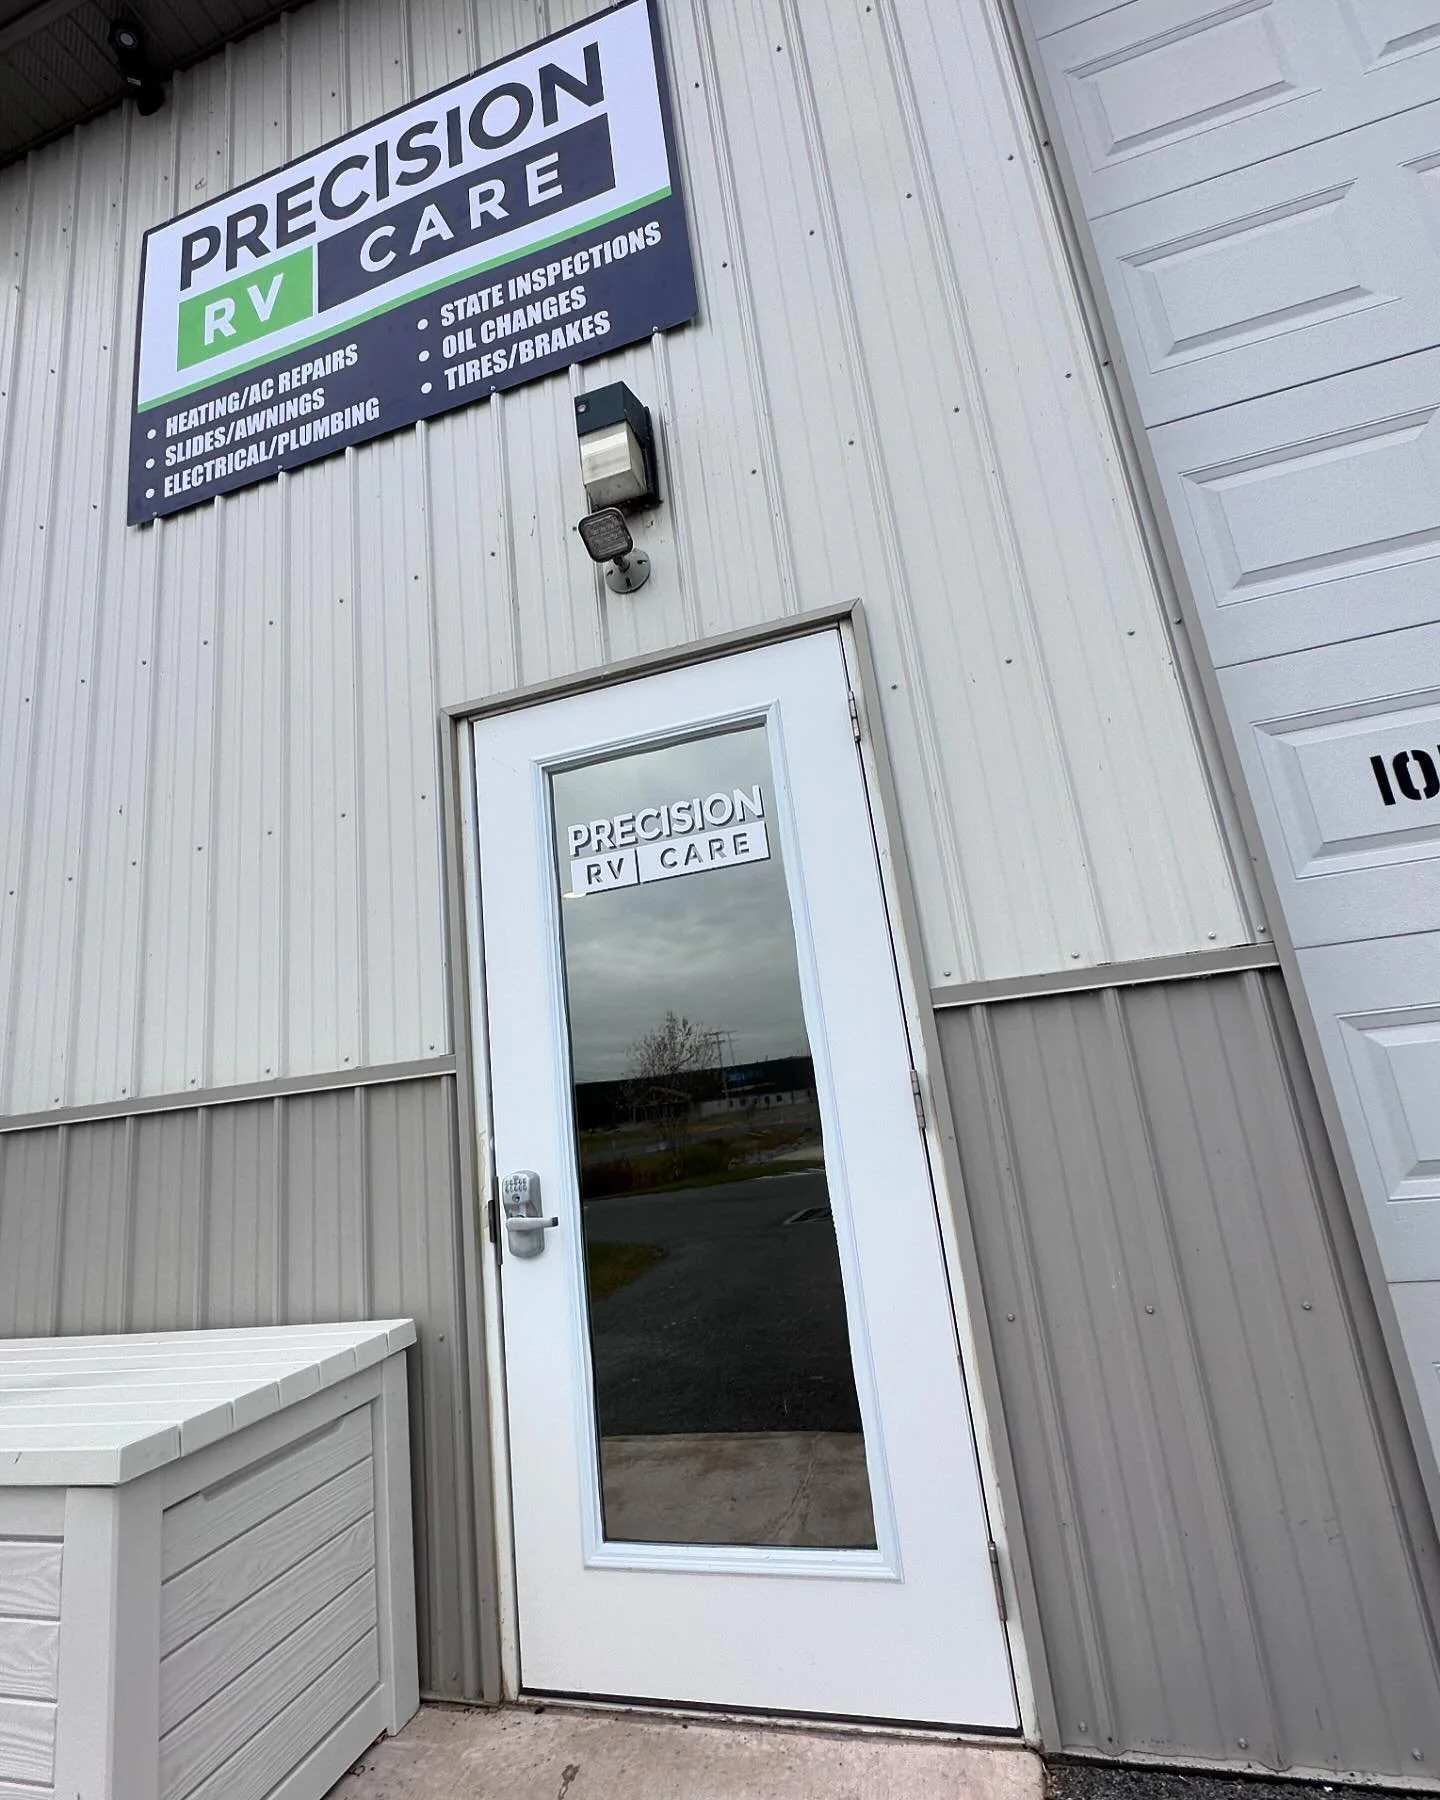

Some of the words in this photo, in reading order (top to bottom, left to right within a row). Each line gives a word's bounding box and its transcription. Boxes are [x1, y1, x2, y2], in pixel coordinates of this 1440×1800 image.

[180, 42, 604, 291] PRECISION
[203, 273, 283, 345] RV
[359, 152, 564, 273] CARE
[440, 284, 504, 327] STATE
[508, 221, 662, 301] INSPECTIONS
[442, 331, 475, 359] OIL
[480, 285, 586, 343] CHANGES
[444, 310, 611, 391] TIRES/BRAKES
[164, 387, 325, 467] SLIDES/AWNINGS
[165, 377, 274, 438] HEATING/AC
[278, 343, 359, 393] REPAIRS
[163, 397, 380, 498] ELECTRICAL/PLUMBING
[1370, 744, 1440, 806] 10
[568, 784, 765, 857] PRECISION
[586, 858, 624, 885] RV
[660, 832, 750, 869] CARE
